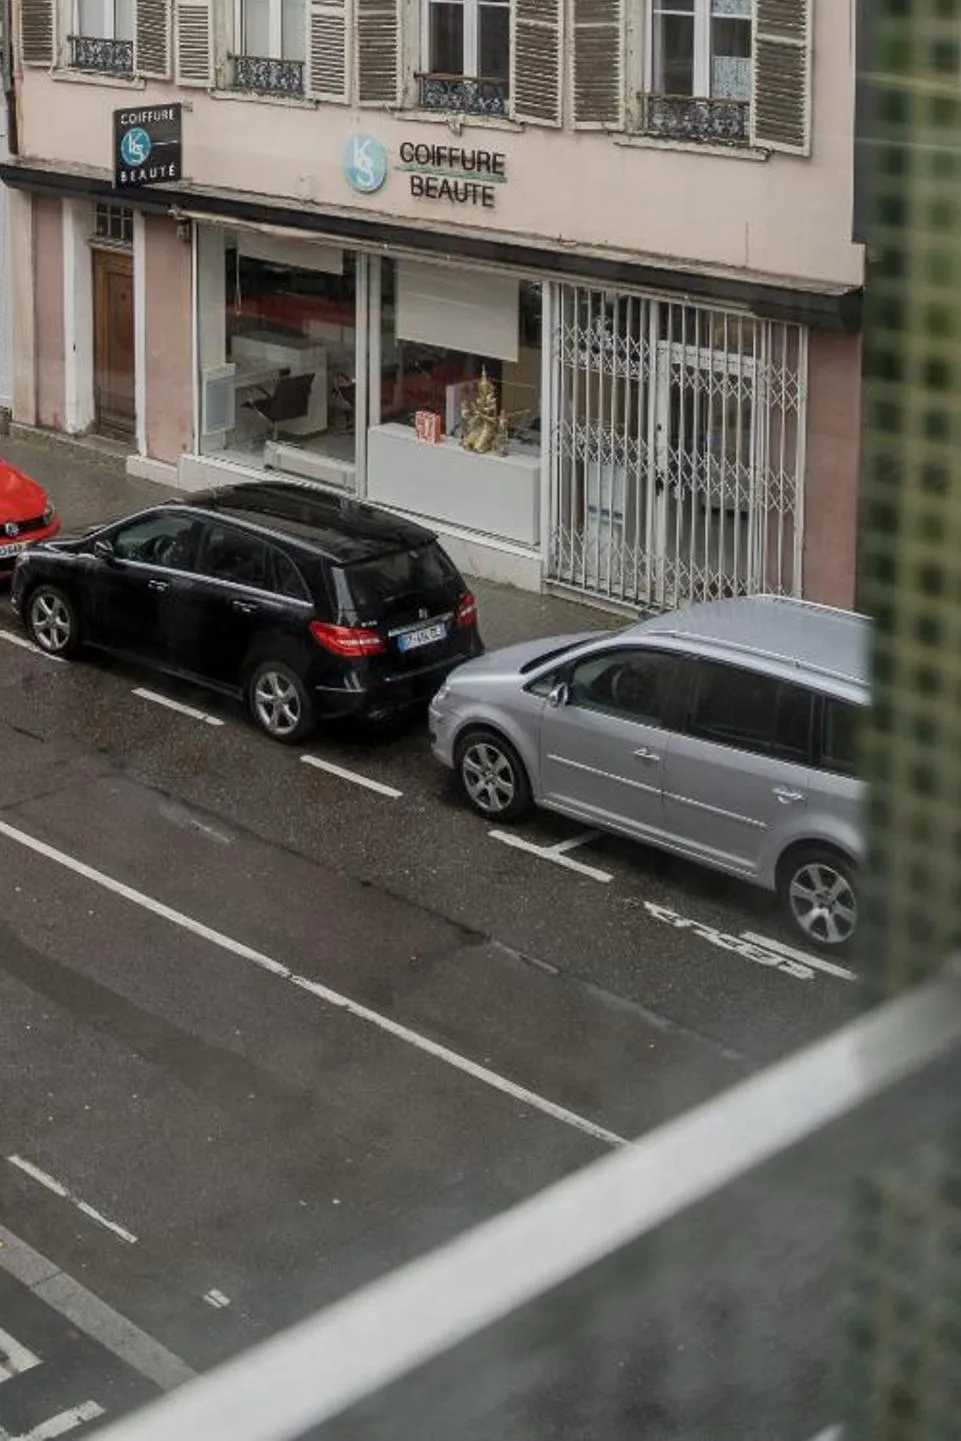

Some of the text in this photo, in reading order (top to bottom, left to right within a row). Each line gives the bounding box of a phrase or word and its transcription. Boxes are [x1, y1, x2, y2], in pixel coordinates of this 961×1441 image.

[120, 109, 174, 125] COIFFURE
[120, 162, 176, 182] BEAUTÉ
[399, 141, 506, 176] COIFFURE
[409, 174, 496, 208] BEAUTE
